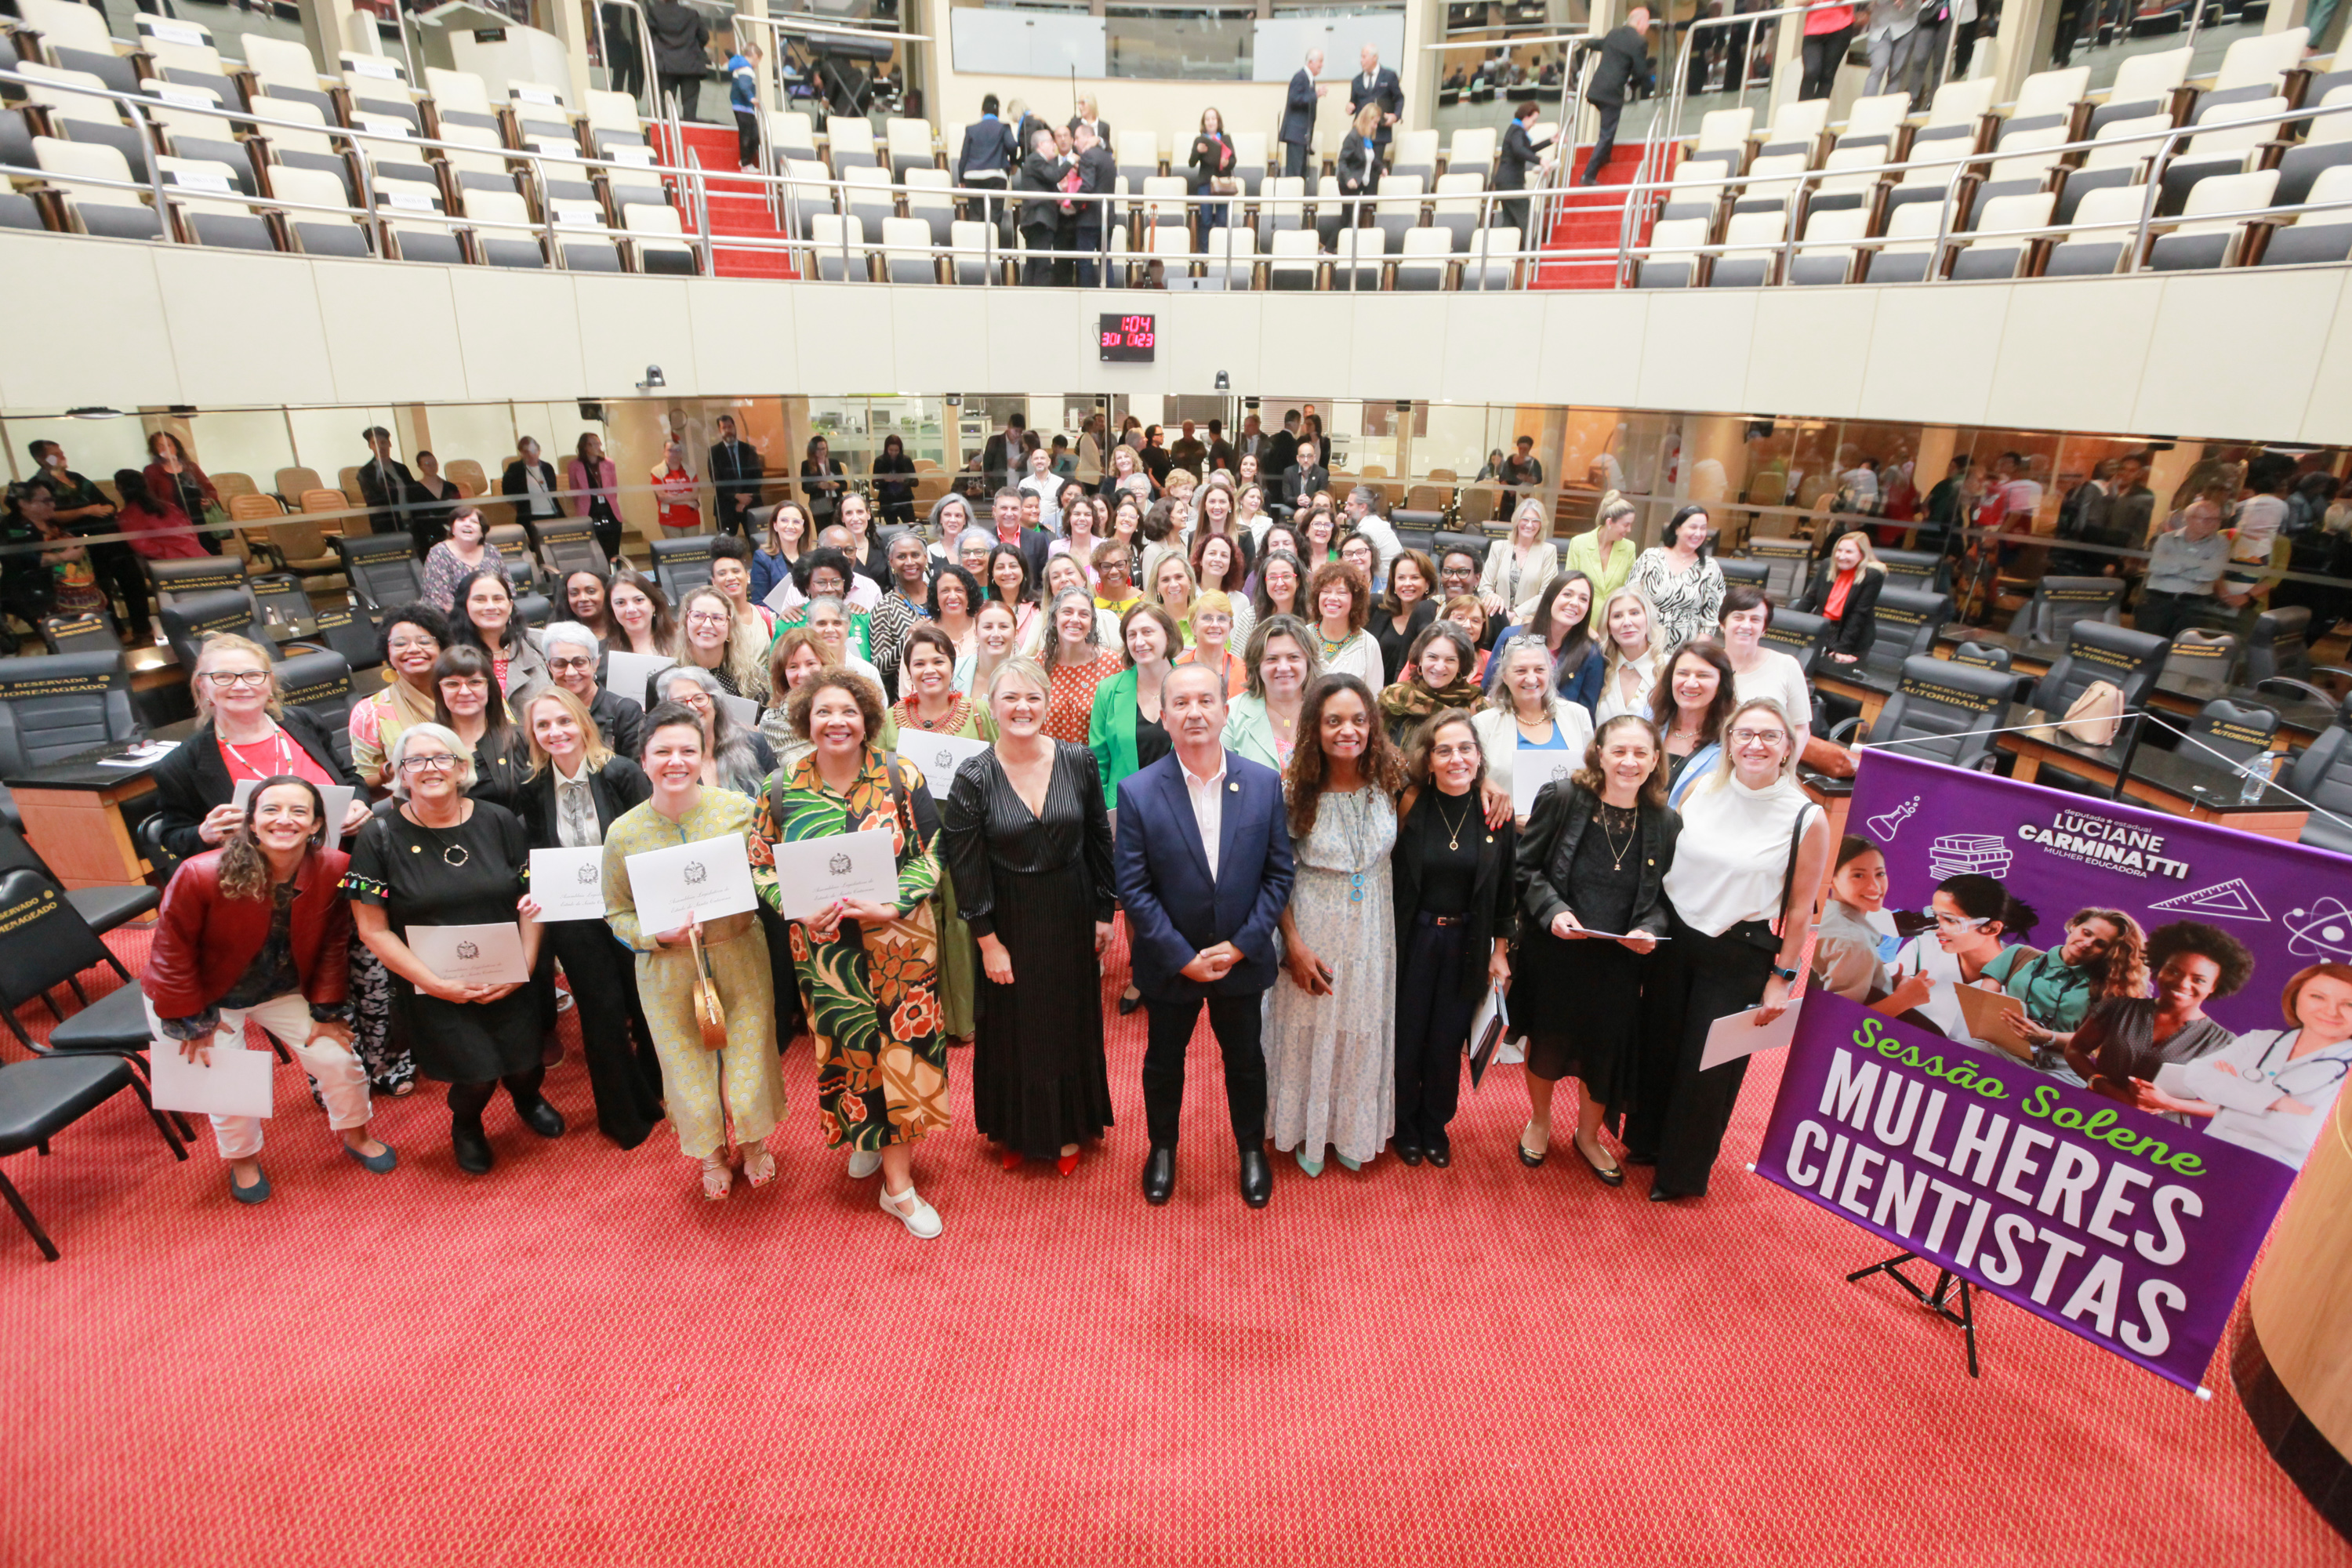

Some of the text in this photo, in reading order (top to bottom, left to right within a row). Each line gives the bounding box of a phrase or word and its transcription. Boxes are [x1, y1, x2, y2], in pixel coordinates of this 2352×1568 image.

[1121, 316, 1151, 332] 1:04
[162, 579, 241, 590] HOMENAGEADO
[174, 575, 227, 584] RESERVADO
[201, 614, 242, 627] RESERVADO
[318, 619, 353, 630] OMENAGEADO
[1875, 612, 1922, 625] TORIDADE
[1763, 633, 1809, 646] ORIDADE
[1767, 627, 1802, 638] SERVADO
[2071, 650, 2134, 670] AUTORIDADE
[14, 677, 89, 688] RESERVADO
[1919, 682, 1979, 700] RESERVADO
[283, 686, 347, 706] MENAGEADO
[1901, 686, 1990, 712] AUTORIDADE
[2209, 728, 2271, 747] AUTORIDADE
[2223, 724, 2267, 737] RESERVADO
[2064, 808, 2152, 833] deputada estadual
[2053, 813, 2165, 853] LUCIANE
[2018, 824, 2189, 880] CARMINATTI
[2043, 847, 2147, 878] MULHER EDUCADORA
[0, 897, 38, 920] SERVADO
[0, 902, 57, 933] MENAGEADO
[1853, 1018, 2207, 1176] Sessão Solene
[1819, 1047, 2203, 1265] MULHERES
[1786, 1120, 2187, 1356] CIENTISTAS
